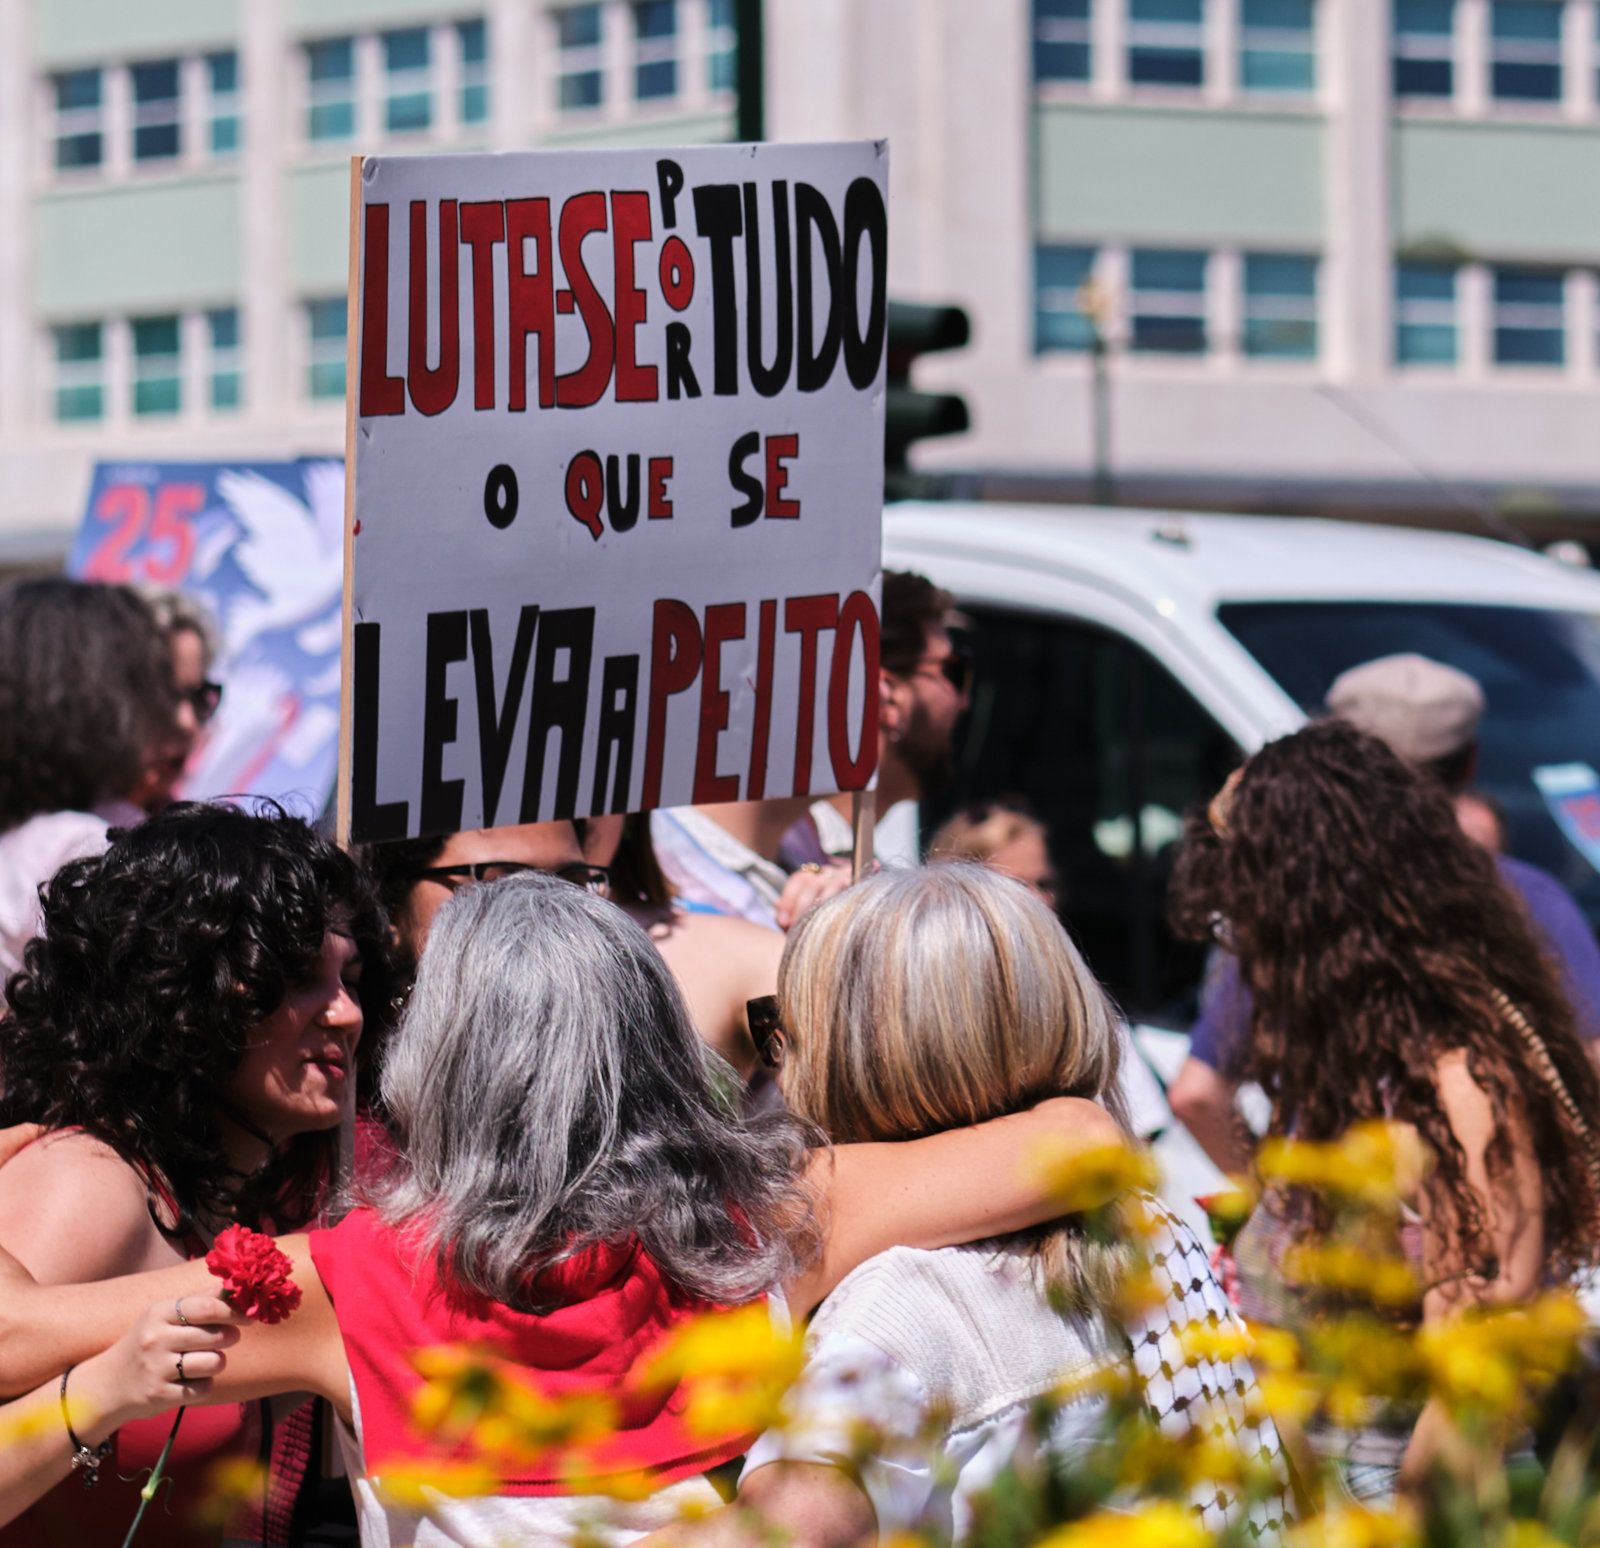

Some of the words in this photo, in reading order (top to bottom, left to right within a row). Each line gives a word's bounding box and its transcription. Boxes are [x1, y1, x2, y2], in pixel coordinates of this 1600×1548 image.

[360, 190, 658, 416] LUTA-SE
[656, 159, 702, 400] POR
[692, 176, 888, 397] TUDO
[82, 483, 205, 586] 25
[483, 463, 519, 530] O
[564, 449, 674, 541] QUE
[728, 431, 801, 528] SE
[351, 604, 596, 844] LEVA
[591, 654, 640, 816] A
[641, 590, 882, 810] PEITO
